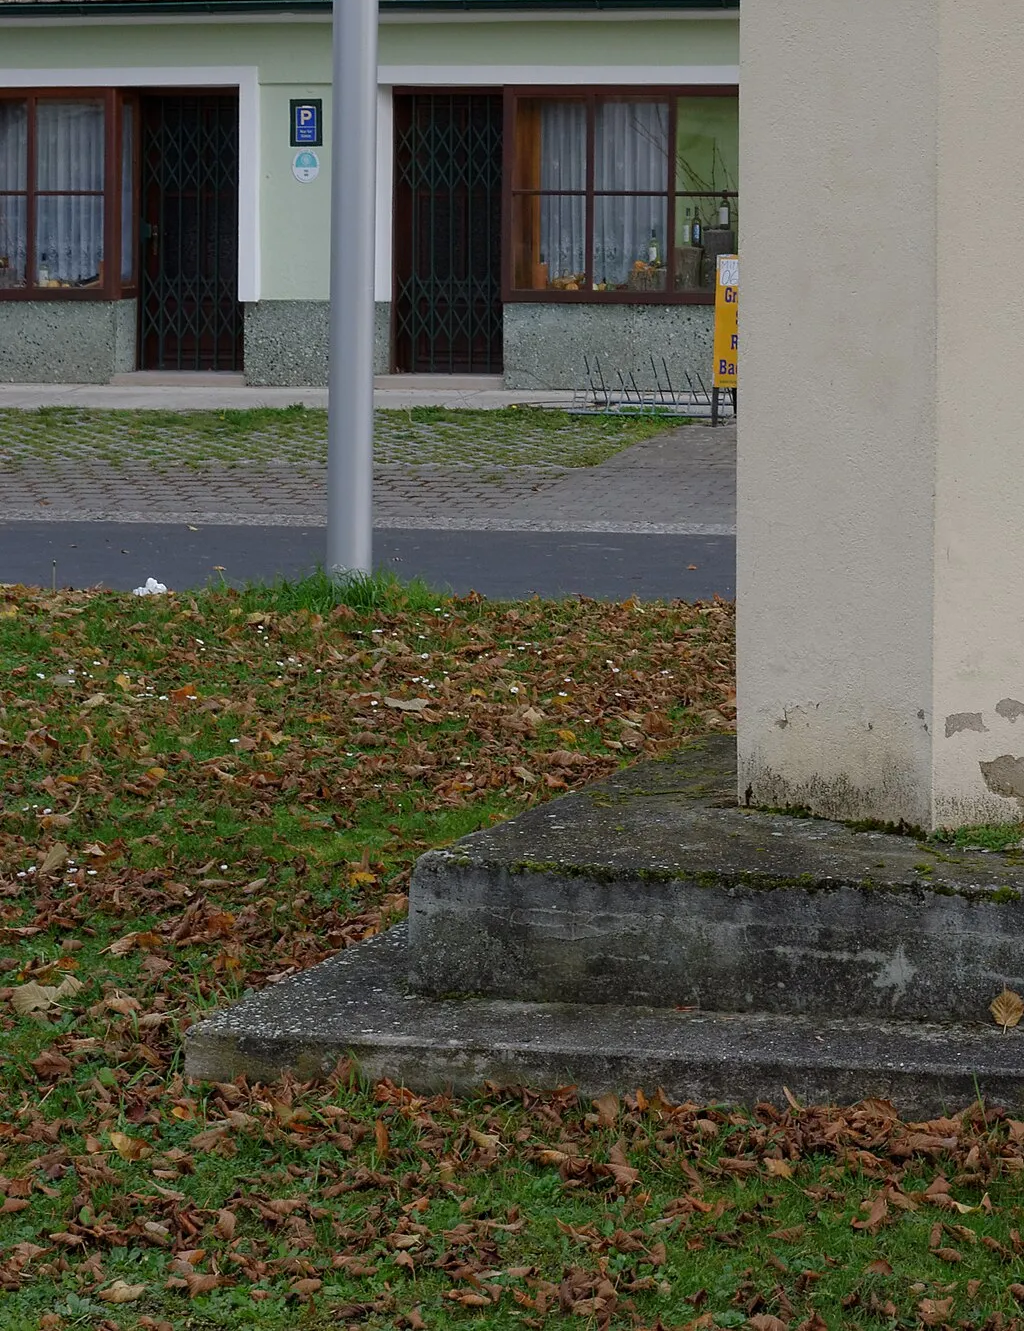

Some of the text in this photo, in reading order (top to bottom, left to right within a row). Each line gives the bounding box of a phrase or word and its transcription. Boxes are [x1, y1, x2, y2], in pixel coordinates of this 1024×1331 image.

[300, 110, 312, 126] P
[725, 286, 738, 303] Gr
[730, 335, 738, 350] R
[719, 359, 738, 375] Ba
